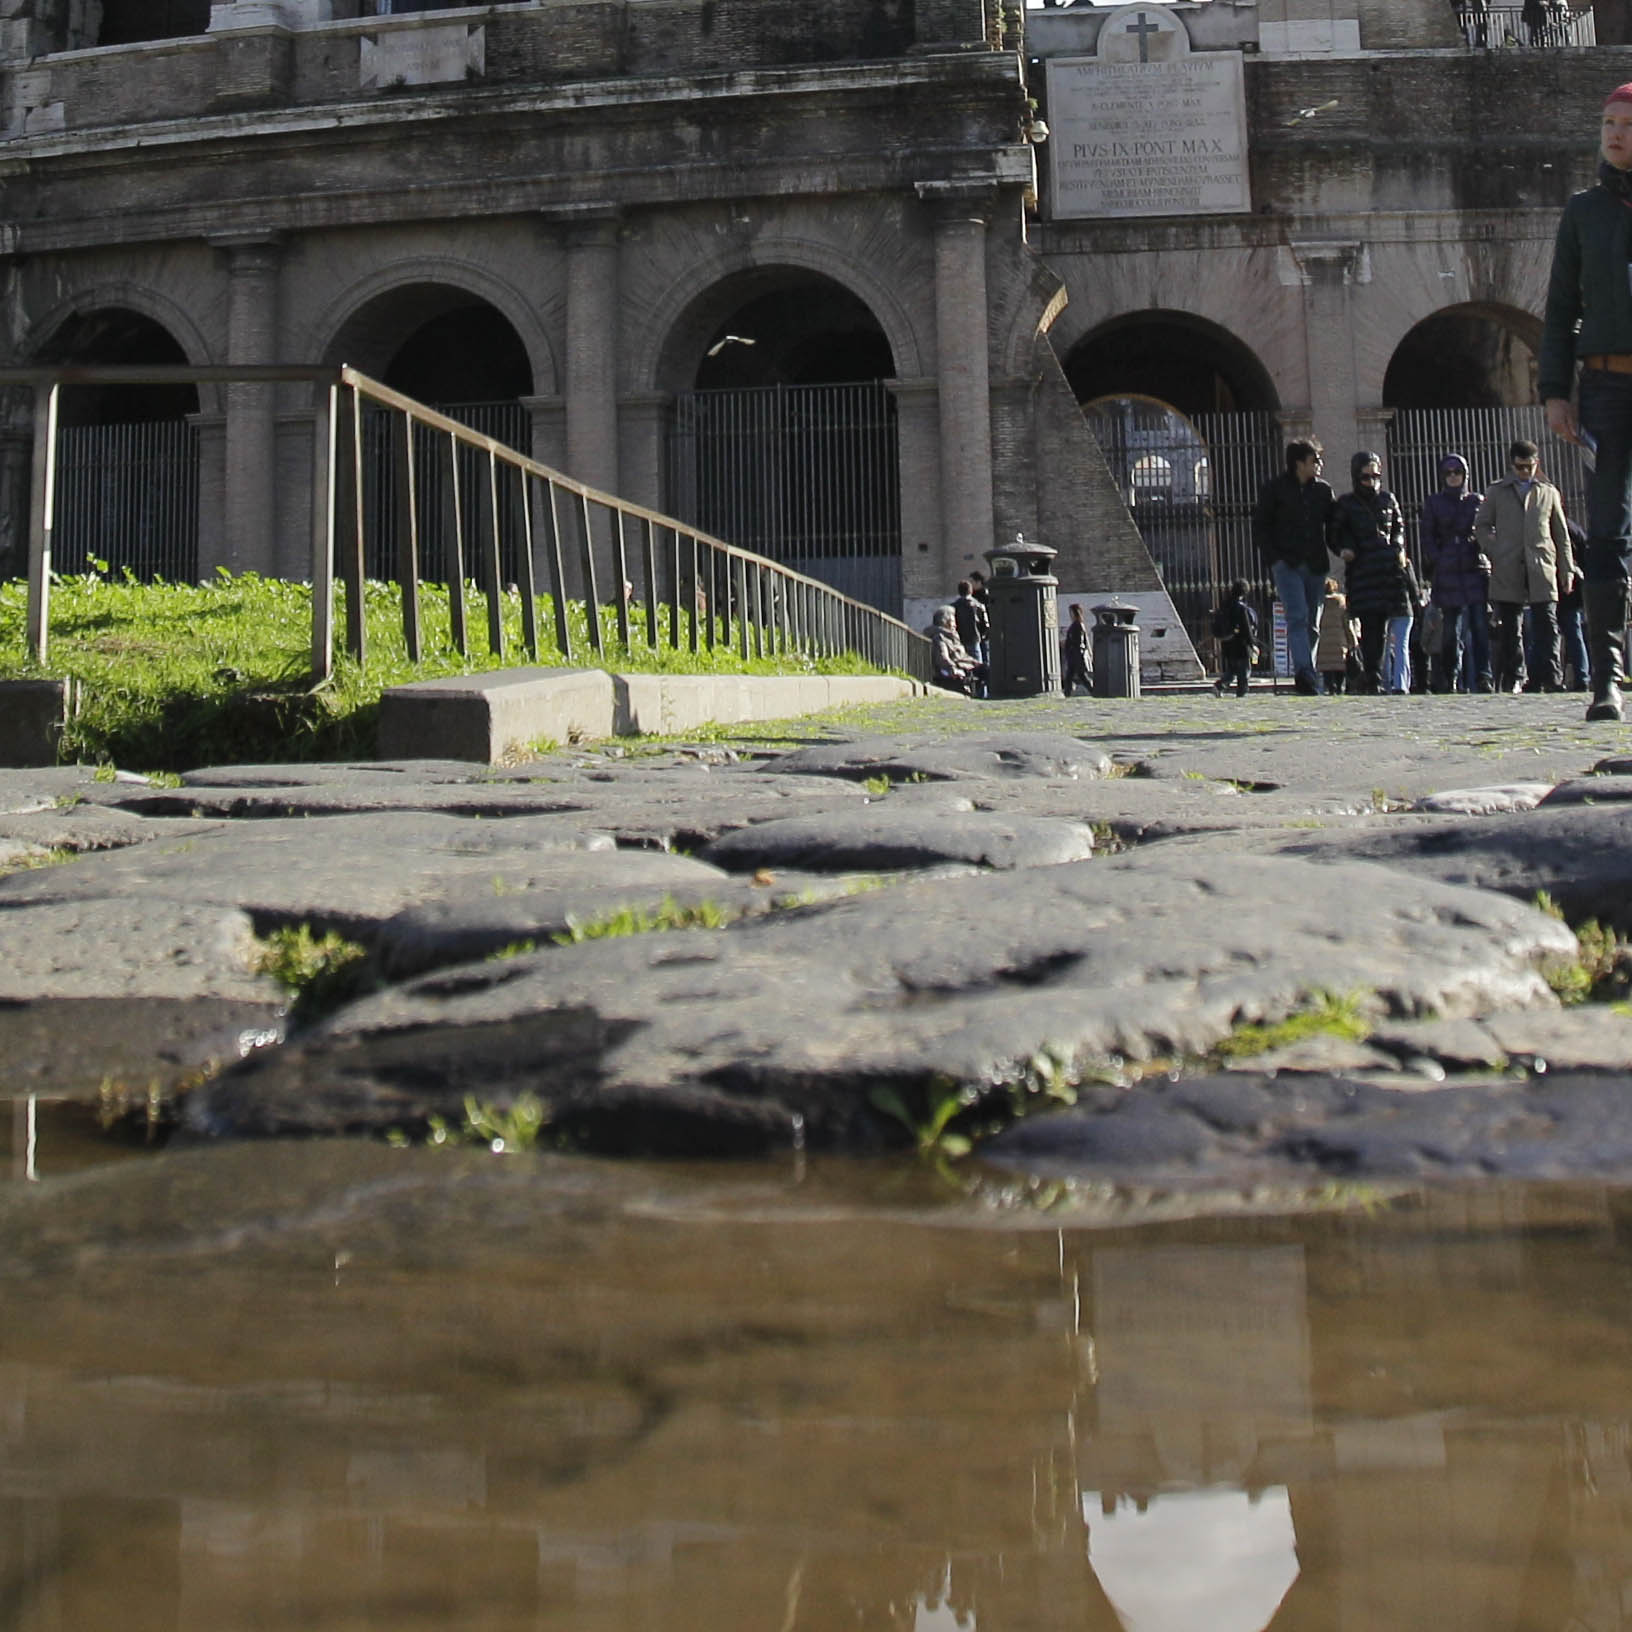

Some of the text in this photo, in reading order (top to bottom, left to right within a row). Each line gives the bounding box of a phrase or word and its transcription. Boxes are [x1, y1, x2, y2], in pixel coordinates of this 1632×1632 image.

[1073, 138, 1223, 158] PIVS IX PONT MAX
